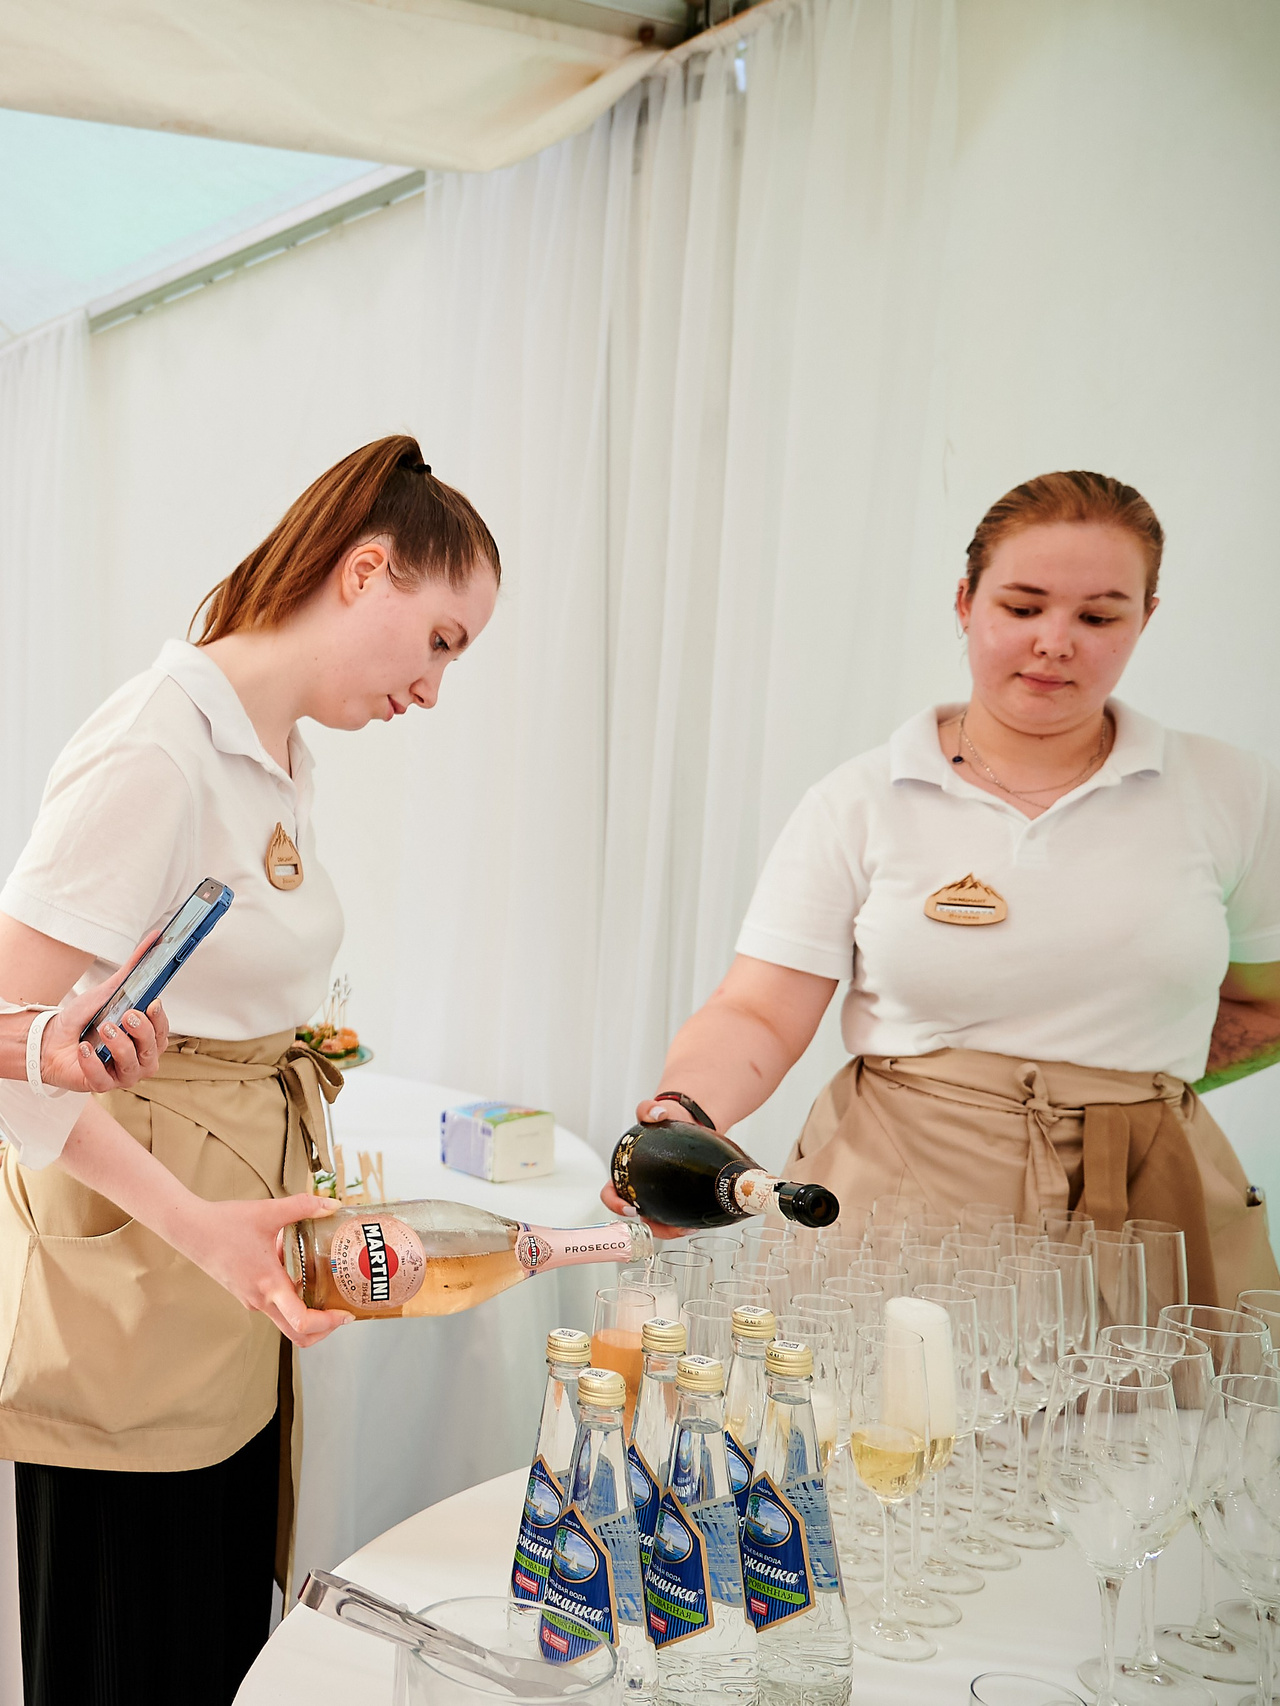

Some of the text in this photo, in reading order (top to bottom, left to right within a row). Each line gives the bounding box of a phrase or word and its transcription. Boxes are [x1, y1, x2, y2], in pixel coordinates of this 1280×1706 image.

[529, 1237, 537, 1266] MARTINI
[565, 1242, 626, 1254] PROSECCO
[342, 1239, 356, 1292] PROSECCO
[363, 1225, 388, 1300] MARTINI
[764, 1554, 782, 1566] ВОДА
[568, 1591, 587, 1602] ВОДА
